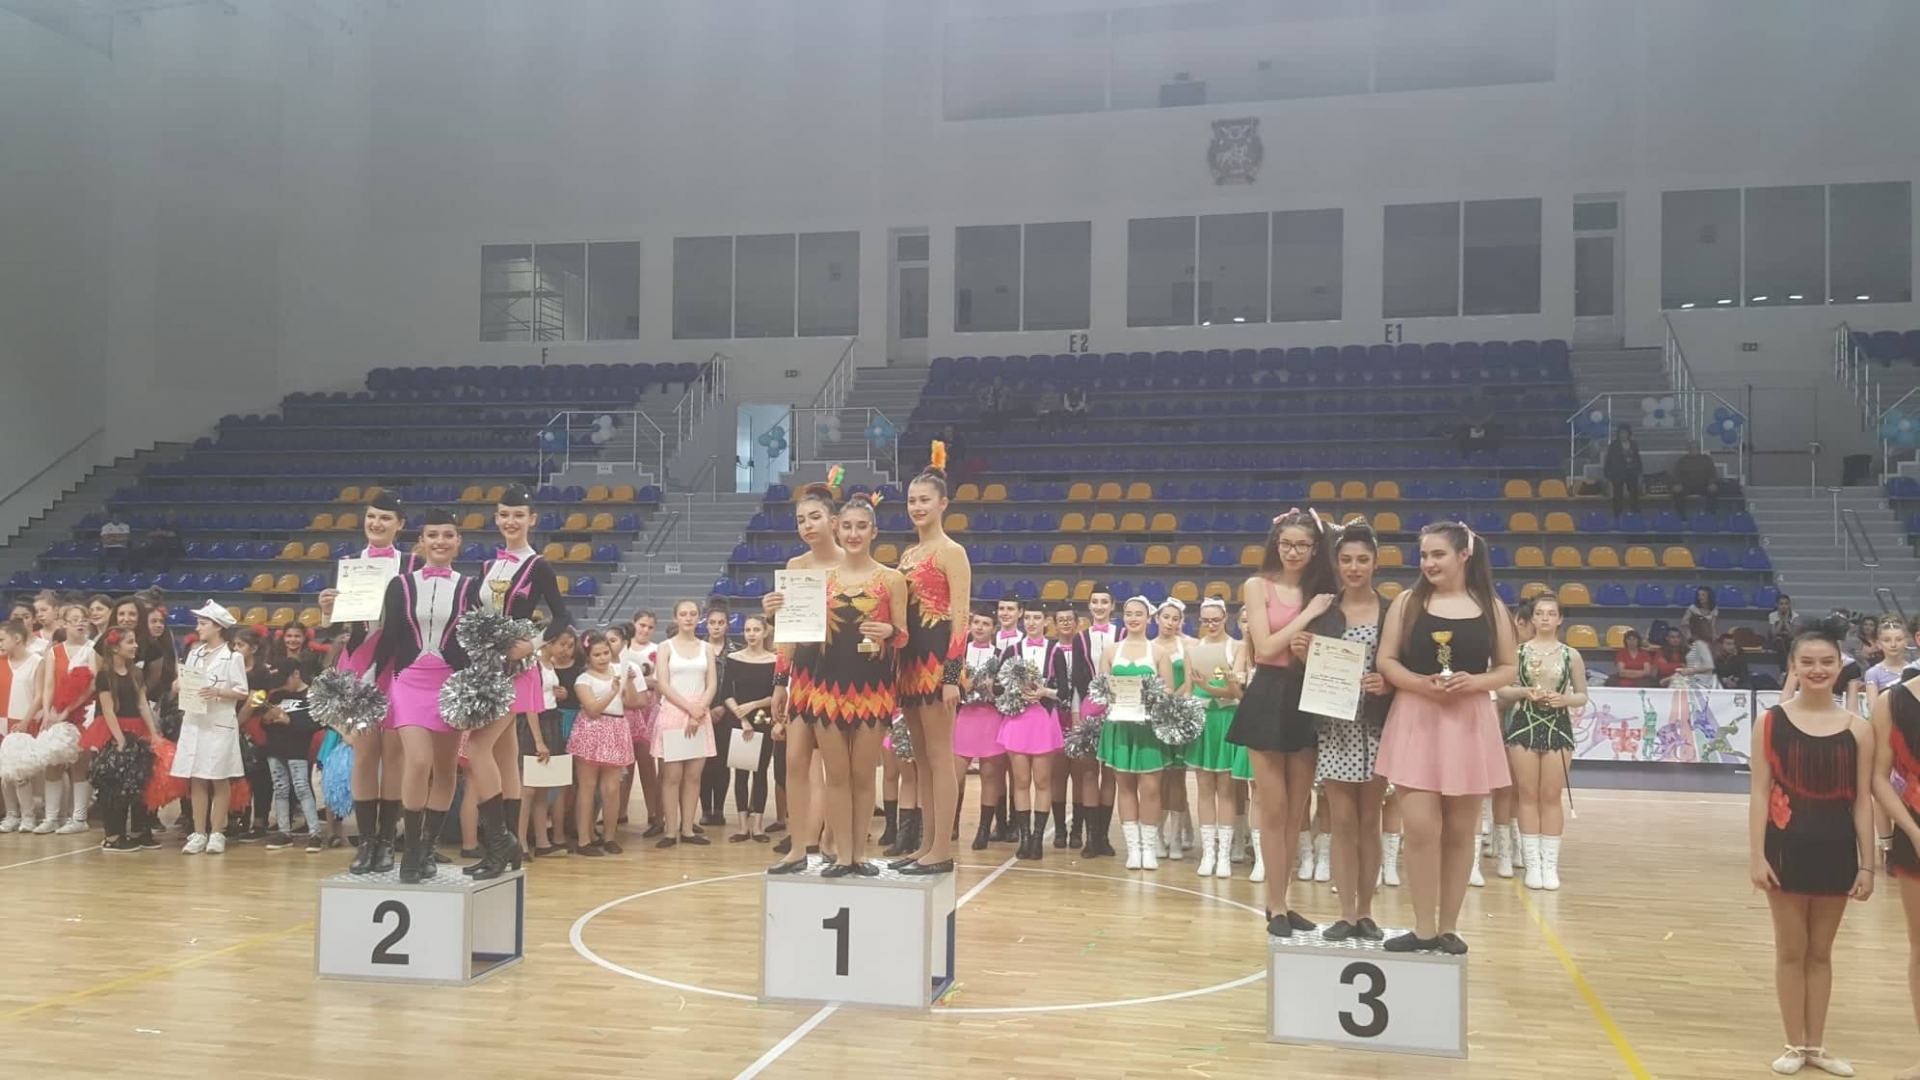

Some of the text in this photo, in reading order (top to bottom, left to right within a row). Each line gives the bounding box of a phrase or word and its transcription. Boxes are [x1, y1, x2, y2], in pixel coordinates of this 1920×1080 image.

[1385, 323, 1402, 343] E1
[1069, 334, 1088, 353] E2
[542, 347, 548, 365] F
[1763, 537, 1770, 546] 5
[371, 899, 411, 965] 2
[822, 907, 850, 976] 1
[1338, 961, 1389, 1038] 3
